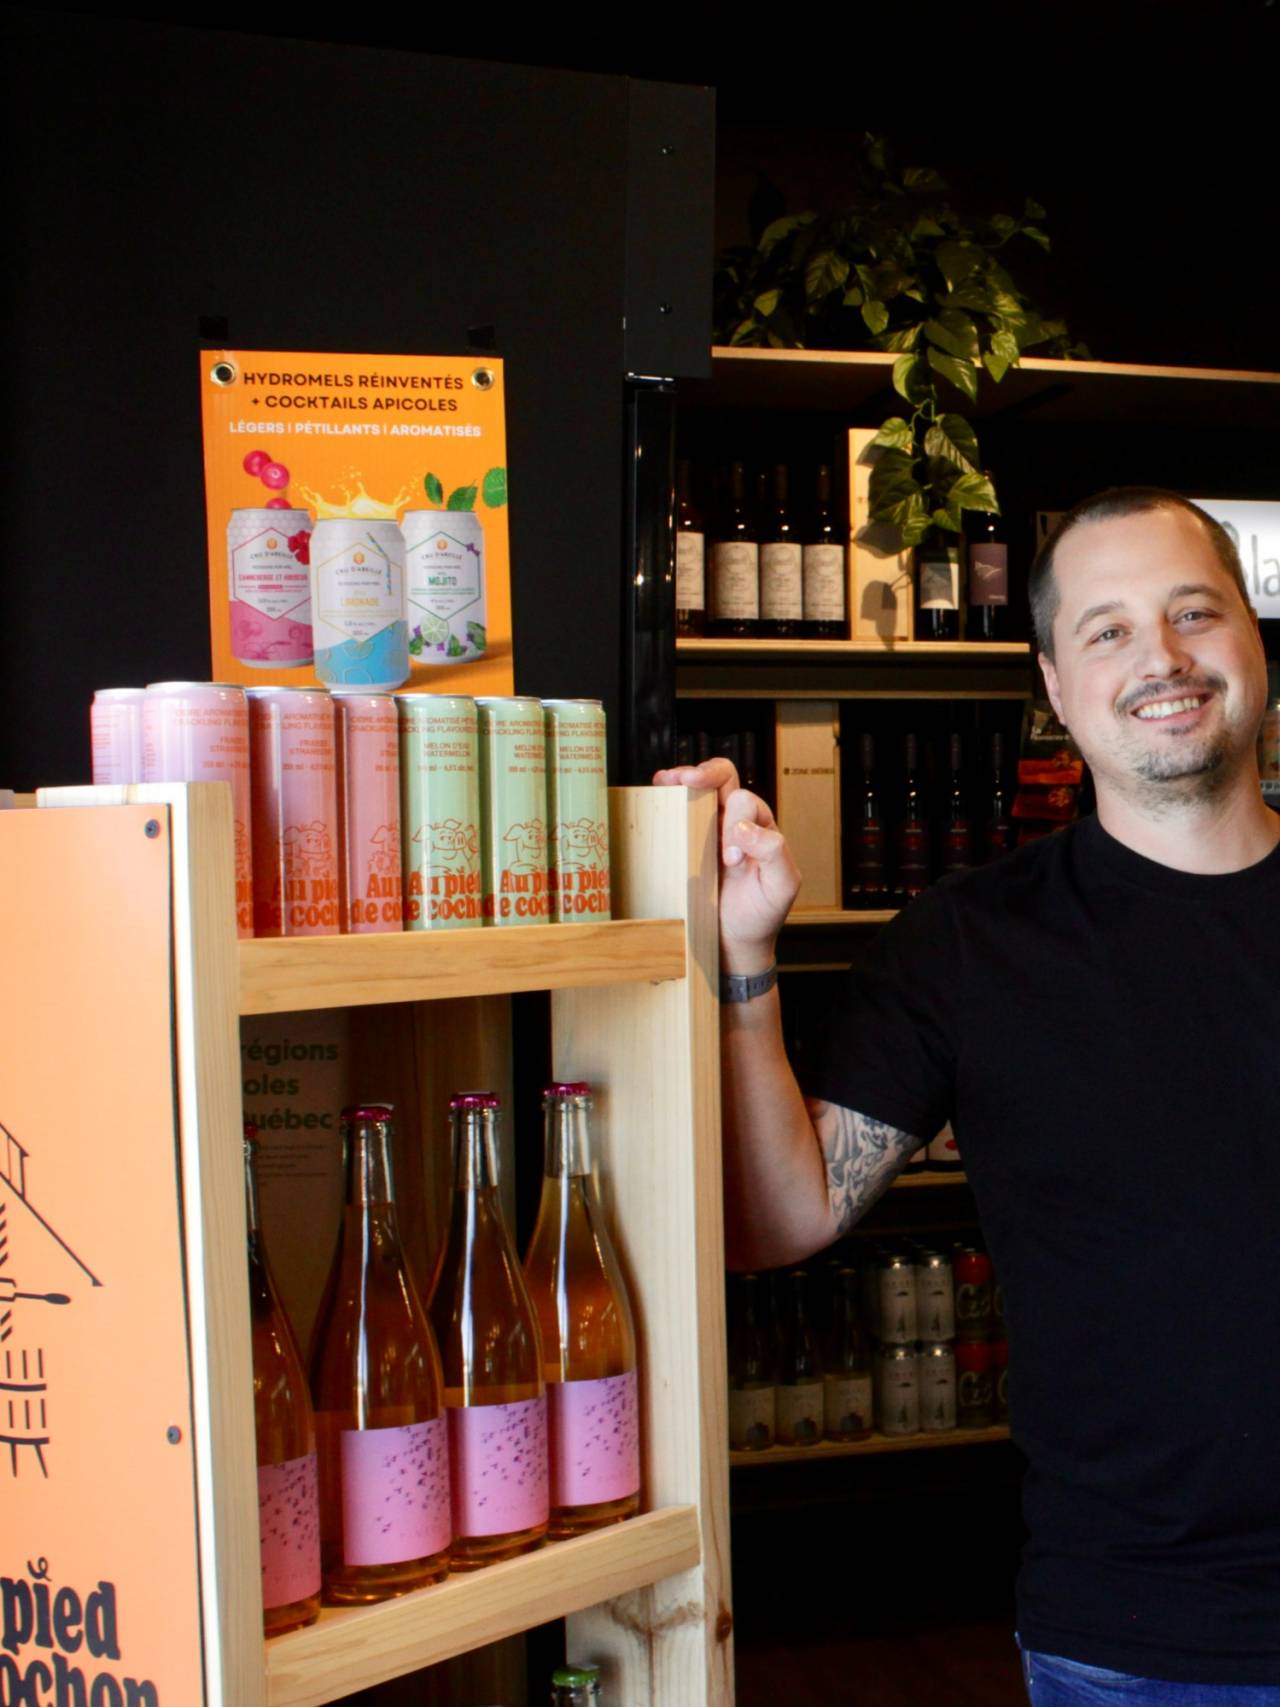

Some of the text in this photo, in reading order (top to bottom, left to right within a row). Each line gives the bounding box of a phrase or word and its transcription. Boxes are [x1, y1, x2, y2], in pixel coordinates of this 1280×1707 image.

[243, 372, 464, 390] HYDROMELS RÉINVENTÉS
[265, 395, 369, 410] COCKTAILS
[372, 397, 458, 412] APICOLES
[229, 420, 482, 437] LÉGERS PÉTILLANTS AROMATISÉS
[427, 575, 458, 587] MOJITO
[366, 873, 393, 898] Au
[500, 868, 529, 893] Au
[0, 1556, 122, 1662] pied
